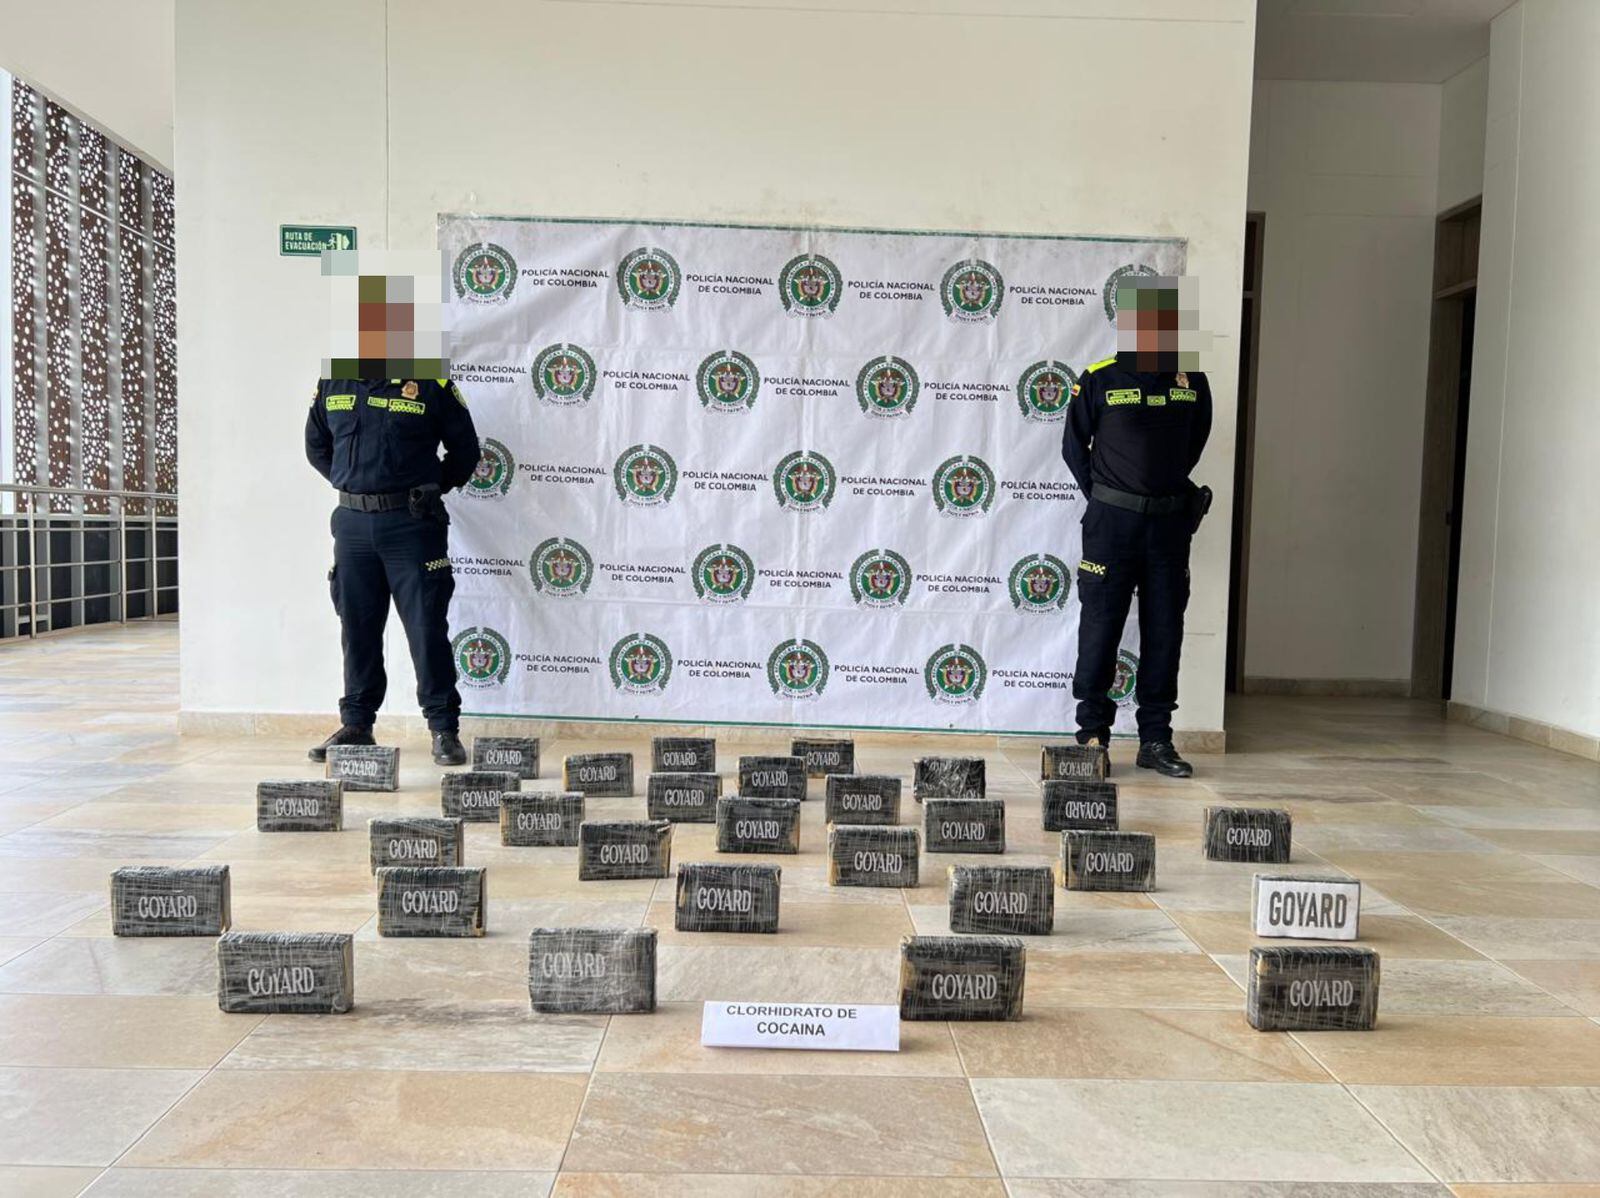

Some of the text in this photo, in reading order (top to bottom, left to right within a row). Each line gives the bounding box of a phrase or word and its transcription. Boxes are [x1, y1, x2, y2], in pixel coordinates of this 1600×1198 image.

[285, 232, 313, 241] RUTA DE
[522, 268, 609, 278] POLICÍA NACIONAL
[548, 280, 597, 288] COLOMBIA
[686, 274, 774, 285] POLICÍA NACIONAL
[849, 280, 935, 290] POLICÍA NACIONAL
[713, 286, 761, 295] COLOMBIA
[1010, 286, 1097, 295] POLICÍA NACIONAL
[874, 292, 922, 300] COLOMBIA
[1036, 297, 1084, 305] COLOMBIA
[450, 363, 527, 374] LICÍA NACIONAL
[466, 375, 514, 383] COLOMBIA
[603, 370, 690, 381] POLICÍA NACIONAL
[629, 382, 678, 390] COLOMBIA
[764, 377, 850, 387] POLICÍA NACIONAL
[924, 382, 960, 390] POLICÍA
[790, 388, 838, 396] COLOMBIA
[950, 393, 998, 401] COLOMBIA
[519, 463, 606, 475] POLICÍA NACIONAL
[546, 475, 594, 484] COLOMBIA
[683, 471, 768, 480] POLICÍA NACIONAL
[841, 476, 877, 484] POLICÍA
[709, 483, 756, 491] COLOMBIA
[1001, 480, 1080, 490] POLICÍA NACION
[867, 488, 914, 496] COLOMBIA
[451, 556, 524, 566] LICÍA NACIONAL
[464, 568, 512, 576] COLOMBIA
[600, 564, 635, 572] POLICÍA
[626, 575, 674, 583] COLOMBIA
[759, 569, 843, 579] POLICÍA NACIONAL
[916, 574, 1002, 583] POLICÍA NACIONAL
[784, 580, 831, 588] COLOMBIA
[942, 585, 990, 593] COLOMBIA
[516, 654, 602, 664] POLICÍA NACIONAL
[678, 659, 762, 669] POLICÍA NACIONAL
[541, 665, 589, 673] COLOMBIA
[703, 670, 750, 678] COLOMBIA
[834, 664, 920, 674] POLICÍA NACIONAL
[860, 675, 907, 683] COLOMBIA
[1031, 671, 1074, 679] NACIONA
[487, 749, 521, 764] GOYARD
[663, 752, 696, 766] GOYARD
[807, 752, 840, 766] GOYARD
[341, 761, 378, 776] GOYARD
[580, 766, 616, 781] GOYARD
[1059, 762, 1093, 776] GOYARD
[752, 771, 788, 787] GOYARD
[665, 790, 704, 806] GOYARD
[843, 794, 882, 810] GOYARD
[276, 800, 318, 816] GOYARD
[1066, 801, 1106, 819] GOYARD
[518, 813, 561, 830] GOYARD
[736, 821, 779, 839] GOYARD
[942, 822, 985, 840] GOYARD
[1227, 829, 1271, 846] GOYARD
[389, 840, 437, 858] GOYARD
[601, 845, 648, 864] GOYARD
[854, 852, 902, 873] GOYARD
[1086, 853, 1134, 872] GOYARD
[402, 891, 458, 913] GOYARD
[698, 888, 751, 912] GOYARD
[974, 892, 1028, 914] GOYARD
[138, 896, 197, 918] GOYARD
[1269, 891, 1346, 929] GOYARD
[543, 952, 606, 978] GOYARD
[248, 967, 315, 995] GOYARD
[932, 975, 997, 1001] GOYARD
[1290, 981, 1353, 1008] GOYARD
[726, 1005, 857, 1019] CLORHIDRATO DE
[757, 1022, 825, 1036] COCAINA
